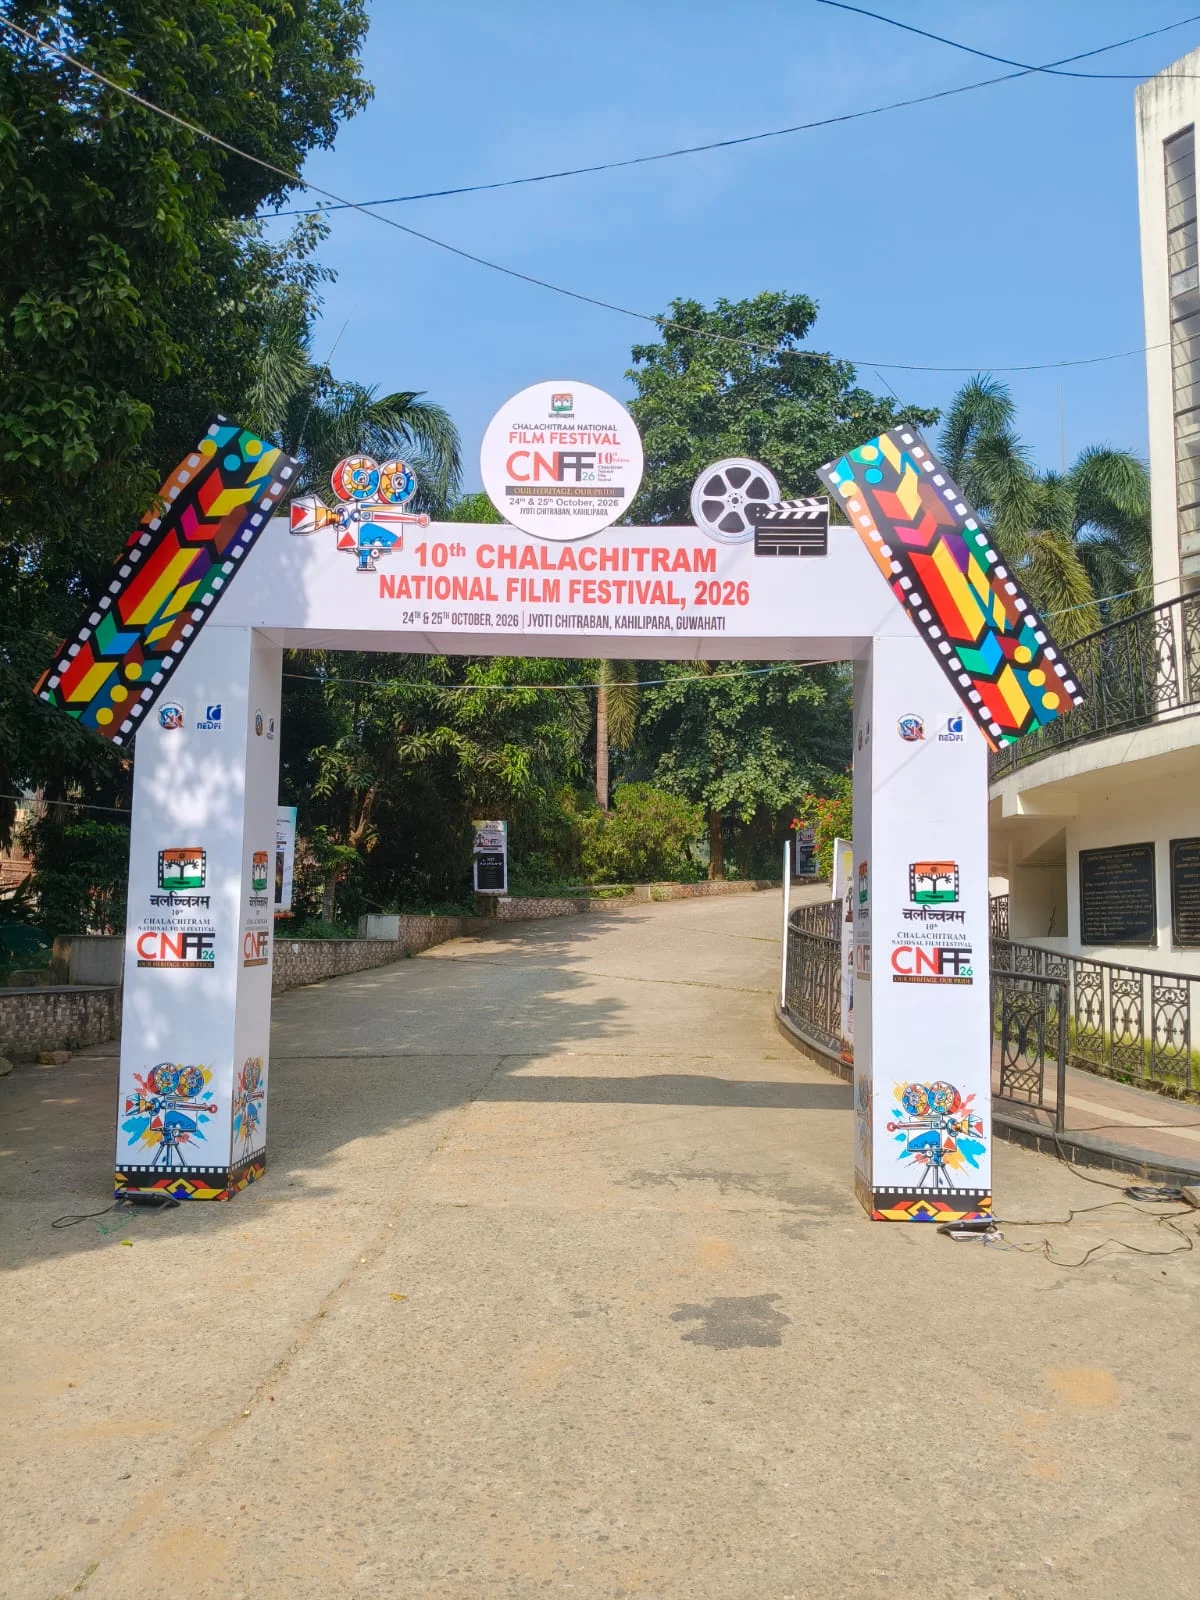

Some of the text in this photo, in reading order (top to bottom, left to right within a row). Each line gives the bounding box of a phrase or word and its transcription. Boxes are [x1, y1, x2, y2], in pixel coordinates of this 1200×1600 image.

[512, 423, 576, 431] CHALACHITRAM
[509, 432, 621, 445] FILM FESTIVAL
[506, 450, 596, 481] CNFF
[582, 472, 595, 481] 26
[520, 507, 608, 516] JYOTI CHITRABAN, KAHILIPARA
[556, 498, 595, 508] October,
[414, 542, 716, 572] 10th CHALACHITRAM
[379, 574, 750, 611] NATIONAL FILM FESTIVAL, 2026
[402, 611, 725, 631] 24TH & 25TH OCTOBER, 2026 JYOTI CHITRABAN, KAHILIPARA, GUWAHATI
[137, 932, 216, 960] CNFF 26
[897, 932, 966, 940] CHALACHITRAM
[891, 946, 972, 975] CNFF
[960, 966, 973, 976] 26
